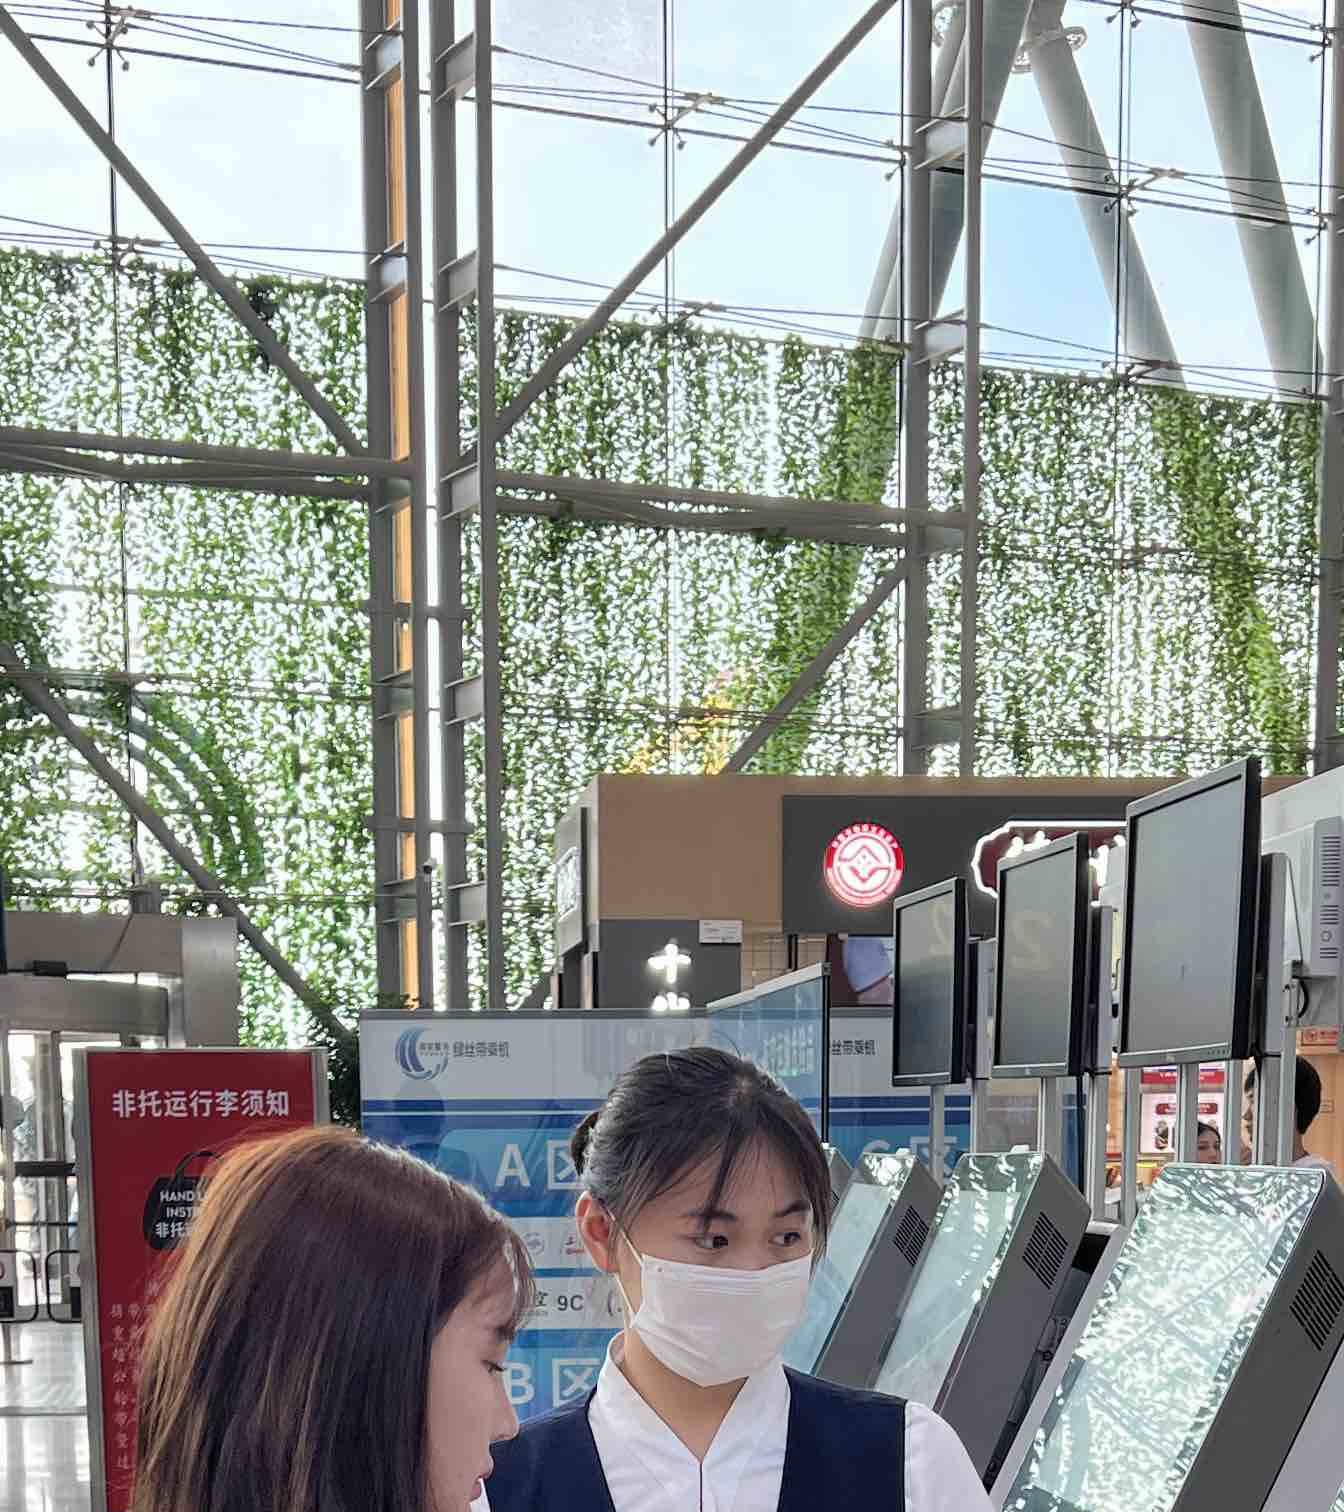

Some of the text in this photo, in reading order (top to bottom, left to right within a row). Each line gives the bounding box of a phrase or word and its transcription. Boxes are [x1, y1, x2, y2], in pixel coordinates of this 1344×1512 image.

[112, 1089, 289, 1118] 非托运行李须知
[495, 1143, 530, 1187] A
[159, 1190, 194, 1203] HAND
[557, 1295, 584, 1312] 9C
[507, 1362, 535, 1405] B
